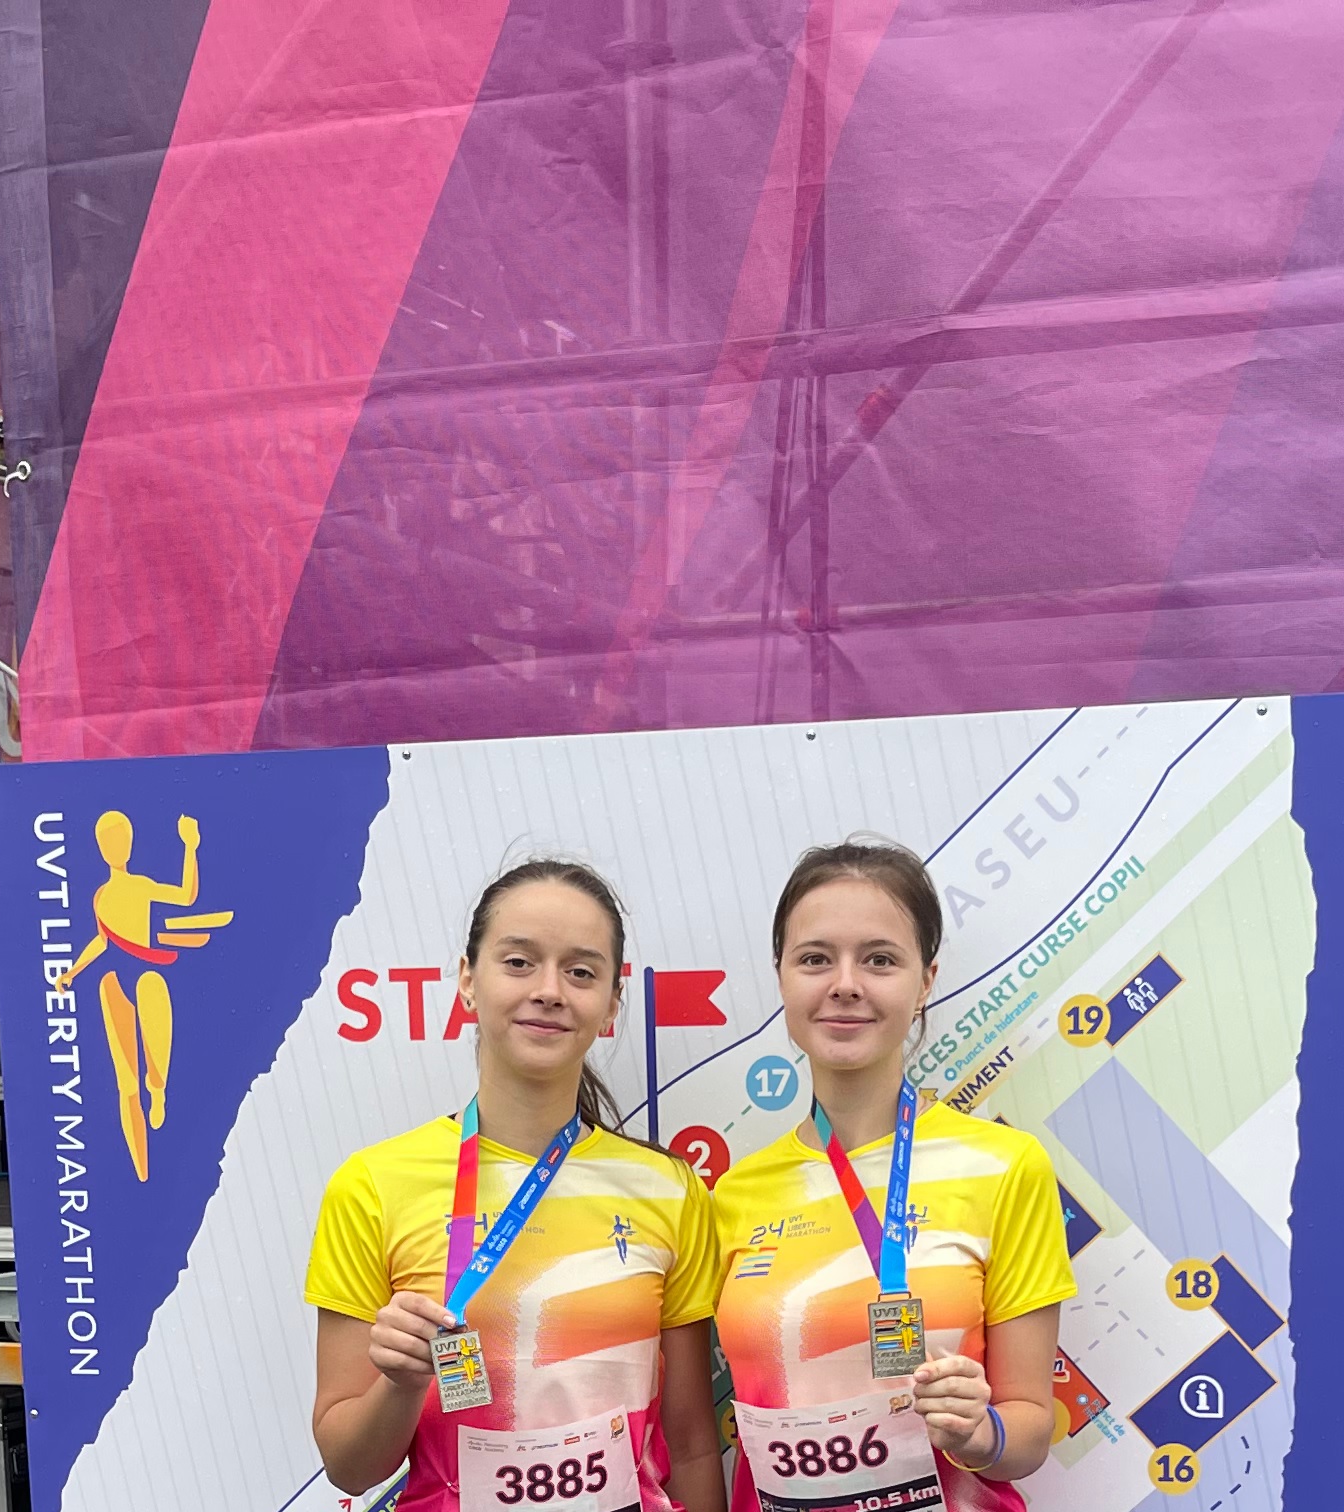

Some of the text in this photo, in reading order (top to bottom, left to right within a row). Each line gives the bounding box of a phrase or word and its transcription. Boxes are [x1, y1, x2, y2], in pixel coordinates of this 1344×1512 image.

[906, 855, 1146, 1088] CCES START CURSE COPII
[955, 991, 1038, 1071] Punct de hidratare
[1066, 1004, 1104, 1036] 19
[33, 811, 100, 1377] UVT LIBERTY MARATHON
[755, 1067, 792, 1099] 17
[686, 1139, 712, 1176] 2
[749, 1218, 786, 1246] 24
[785, 1226, 831, 1239] MARATHON
[787, 1221, 816, 1233] LIBERTY
[788, 1214, 804, 1223] UVT
[1174, 1270, 1212, 1298] 18
[874, 1307, 898, 1317] UVT
[435, 1341, 457, 1353] UVT
[768, 1424, 889, 1478] 3886
[495, 1450, 608, 1505] 3885
[1156, 1454, 1194, 1482] 16
[908, 1484, 939, 1502] km
